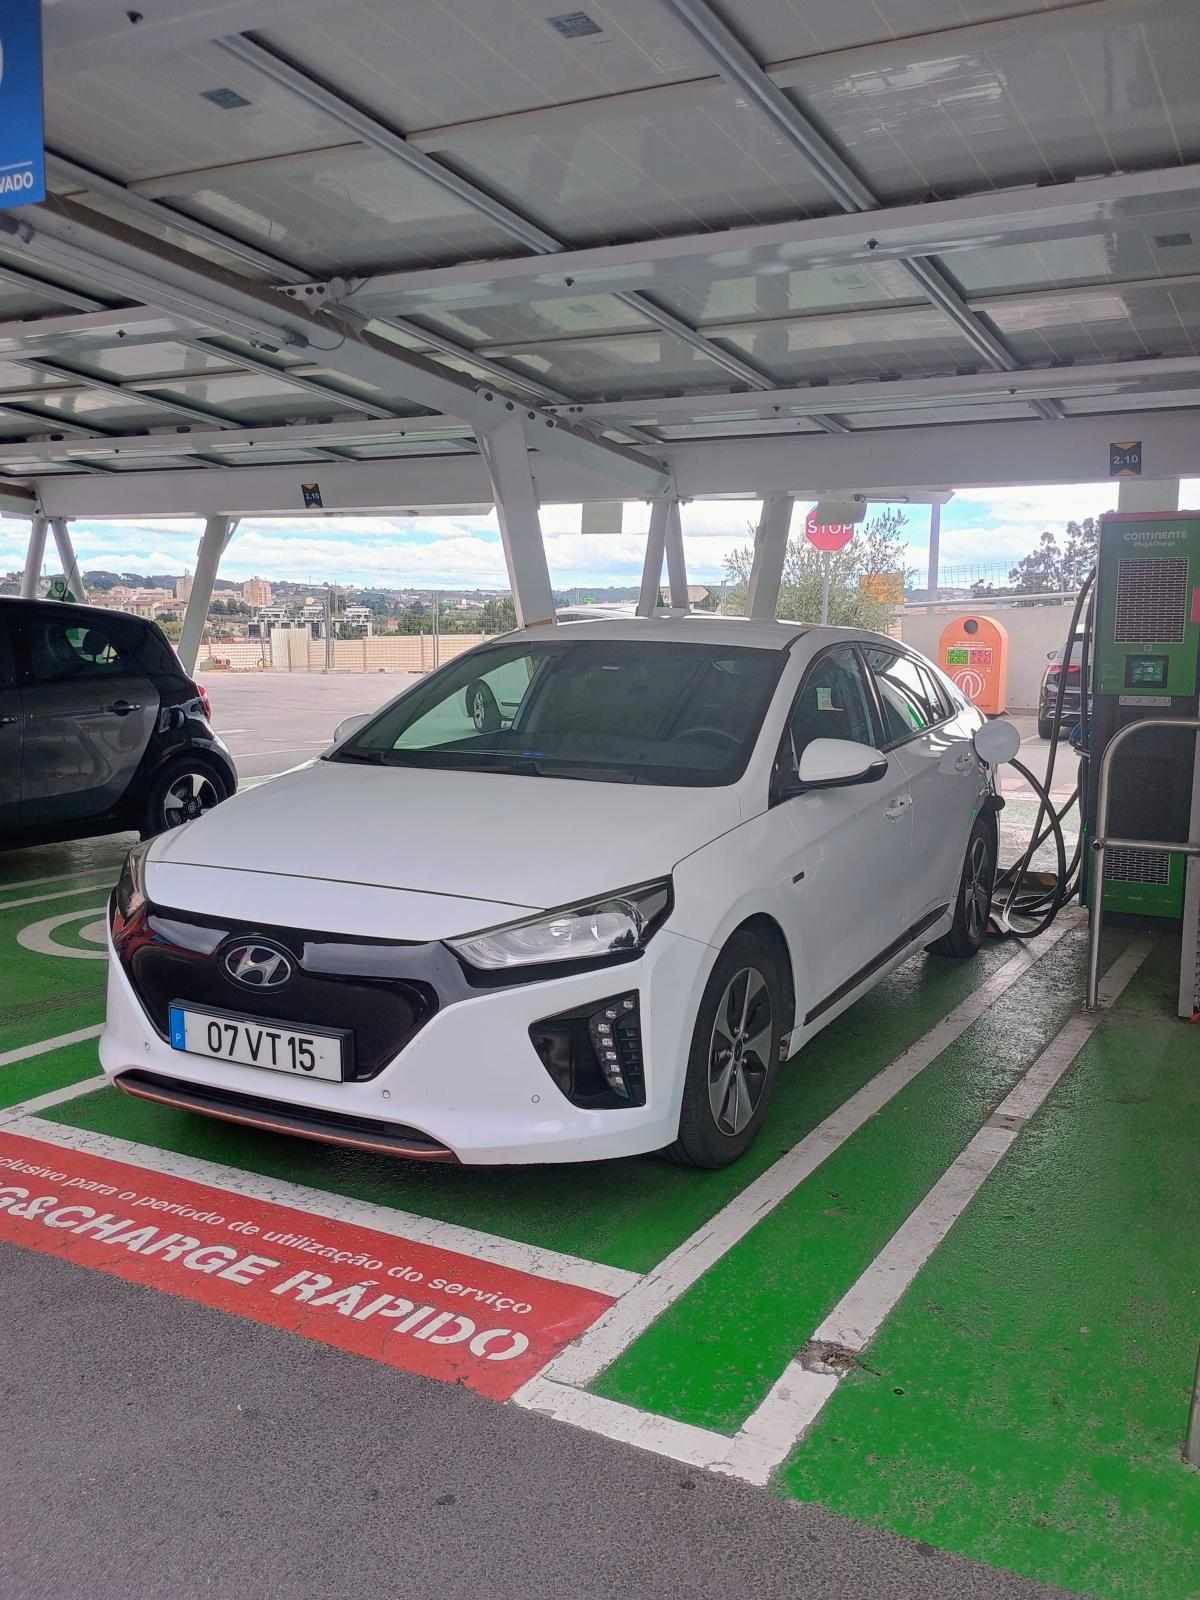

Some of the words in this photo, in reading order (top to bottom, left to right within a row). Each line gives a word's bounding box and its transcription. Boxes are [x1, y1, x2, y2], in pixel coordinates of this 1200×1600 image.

[1112, 454, 1139, 465] 2.10
[0, 1156, 68, 1182] clusivo
[61, 1176, 119, 1197] para
[117, 1191, 137, 1201] o
[130, 1195, 226, 1225] período
[227, 1220, 261, 1236] de
[262, 1230, 383, 1270] utilização
[387, 1266, 424, 1283] do
[427, 1278, 533, 1315] serviço
[0, 1182, 281, 1286] G&CHARGE
[269, 1269, 529, 1361] RÁPIDO
